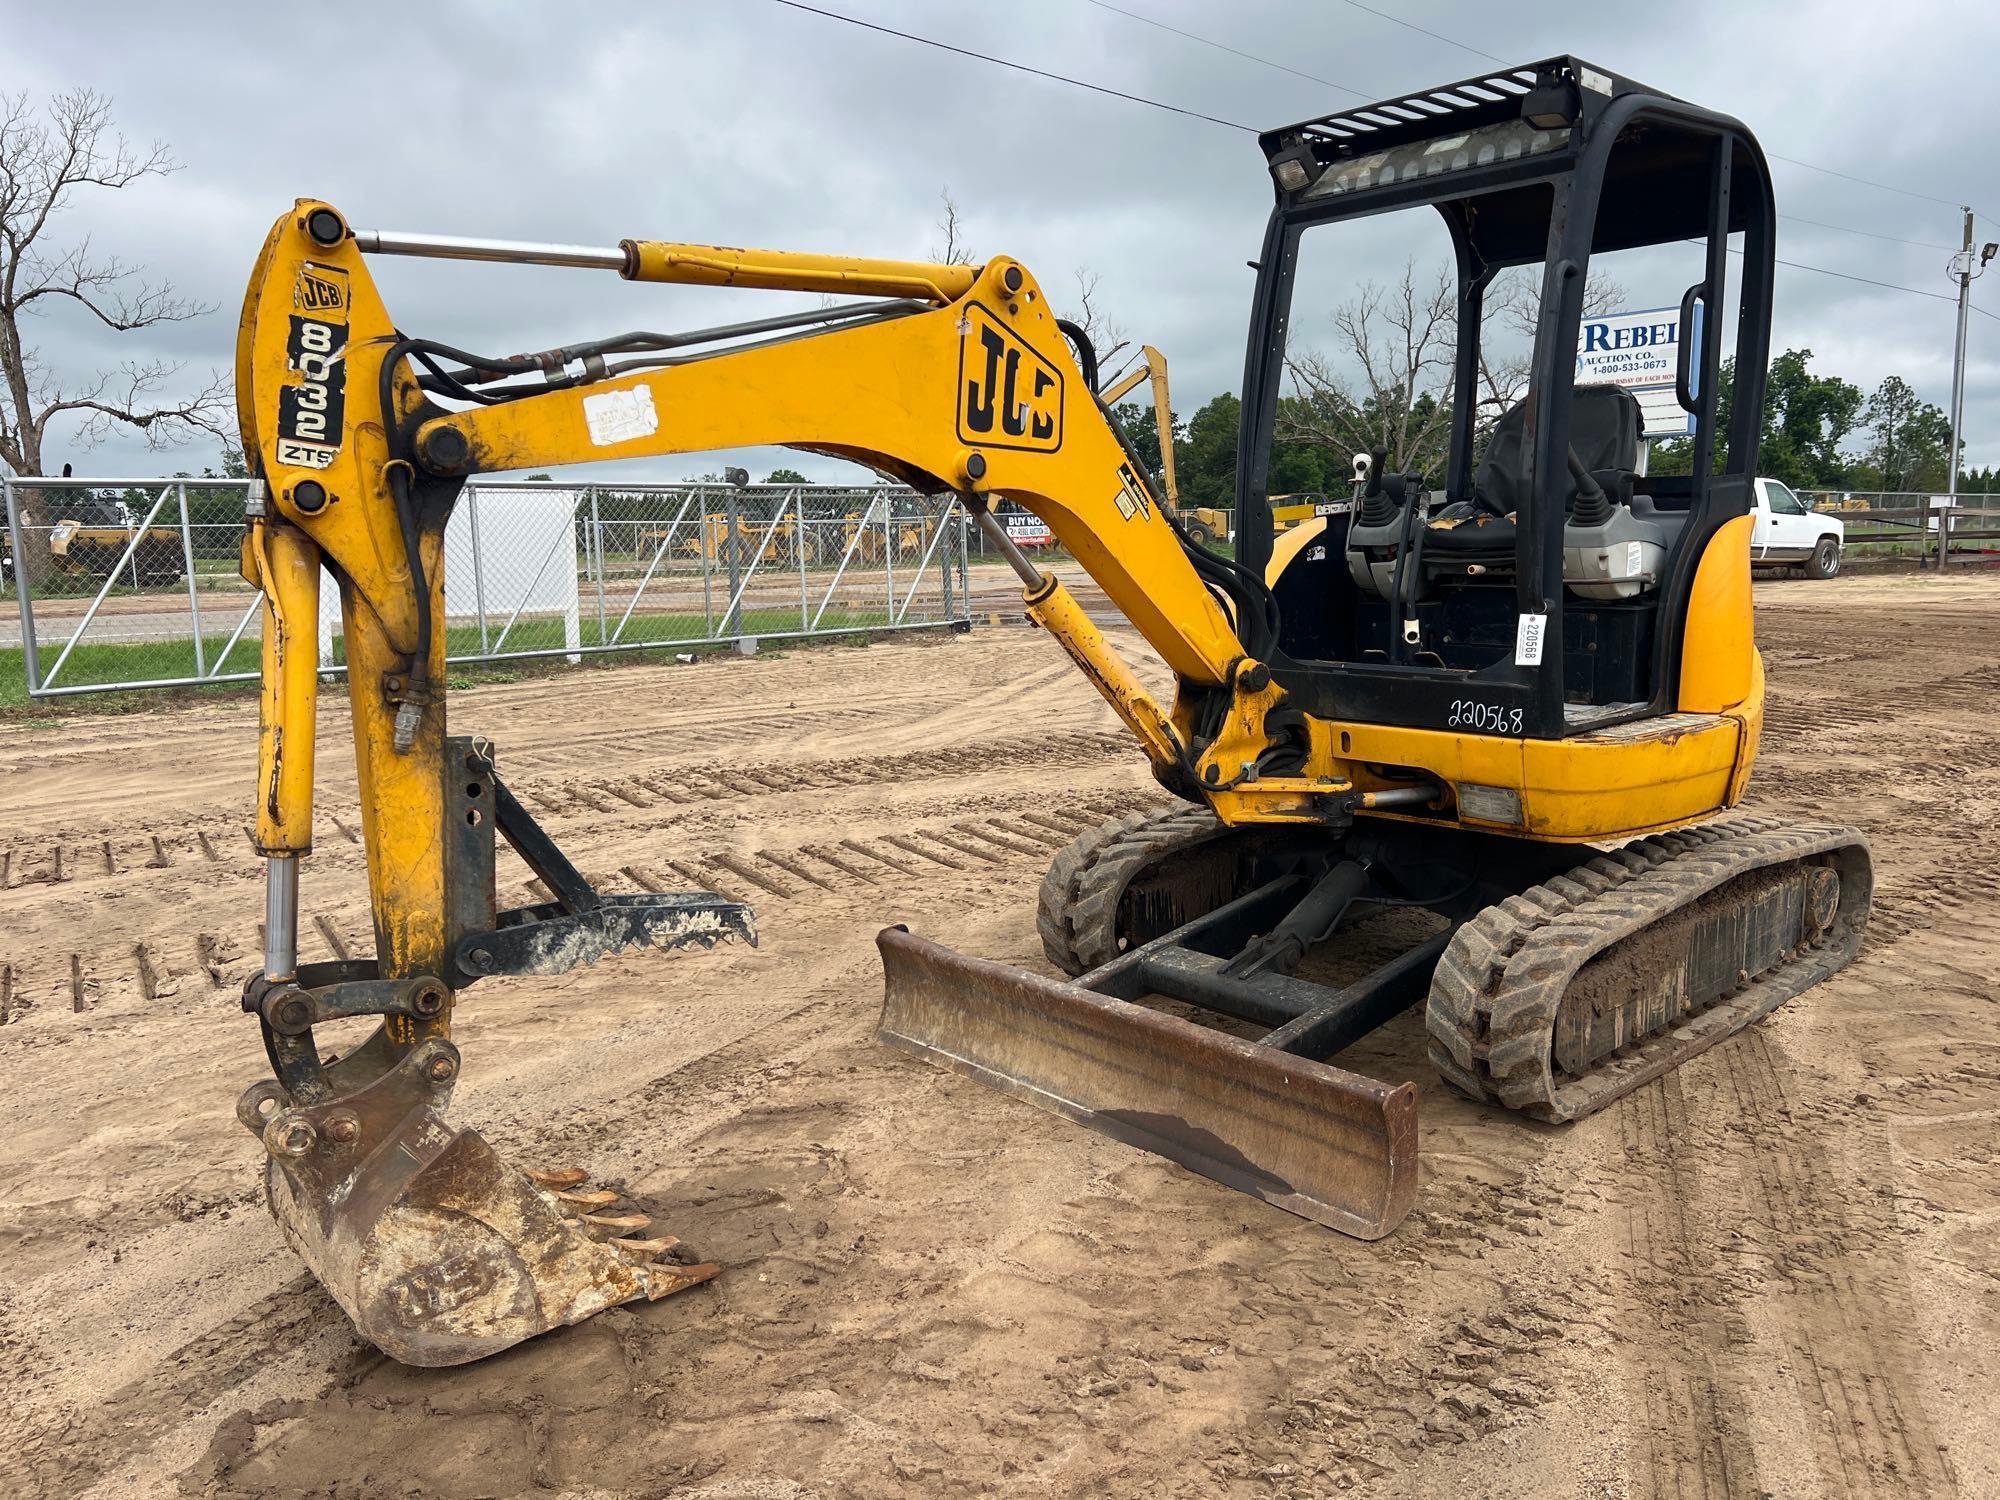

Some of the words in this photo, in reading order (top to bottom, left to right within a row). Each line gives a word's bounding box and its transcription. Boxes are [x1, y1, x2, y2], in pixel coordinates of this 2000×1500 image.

[304, 278, 340, 307] JCB
[1583, 322, 1680, 353] REBEL
[1584, 353, 1632, 366] AUCTION
[1635, 351, 1654, 361] CO.
[1593, 359, 1667, 375] 1-800-533-0673
[295, 322, 332, 441] 8032
[967, 323, 1056, 440] JCB
[1661, 373, 1676, 381] MON
[1008, 516, 1026, 526] BUY
[1027, 516, 1045, 526] NO
[1525, 624, 1540, 659] 220568
[1448, 700, 1523, 734] 220568
